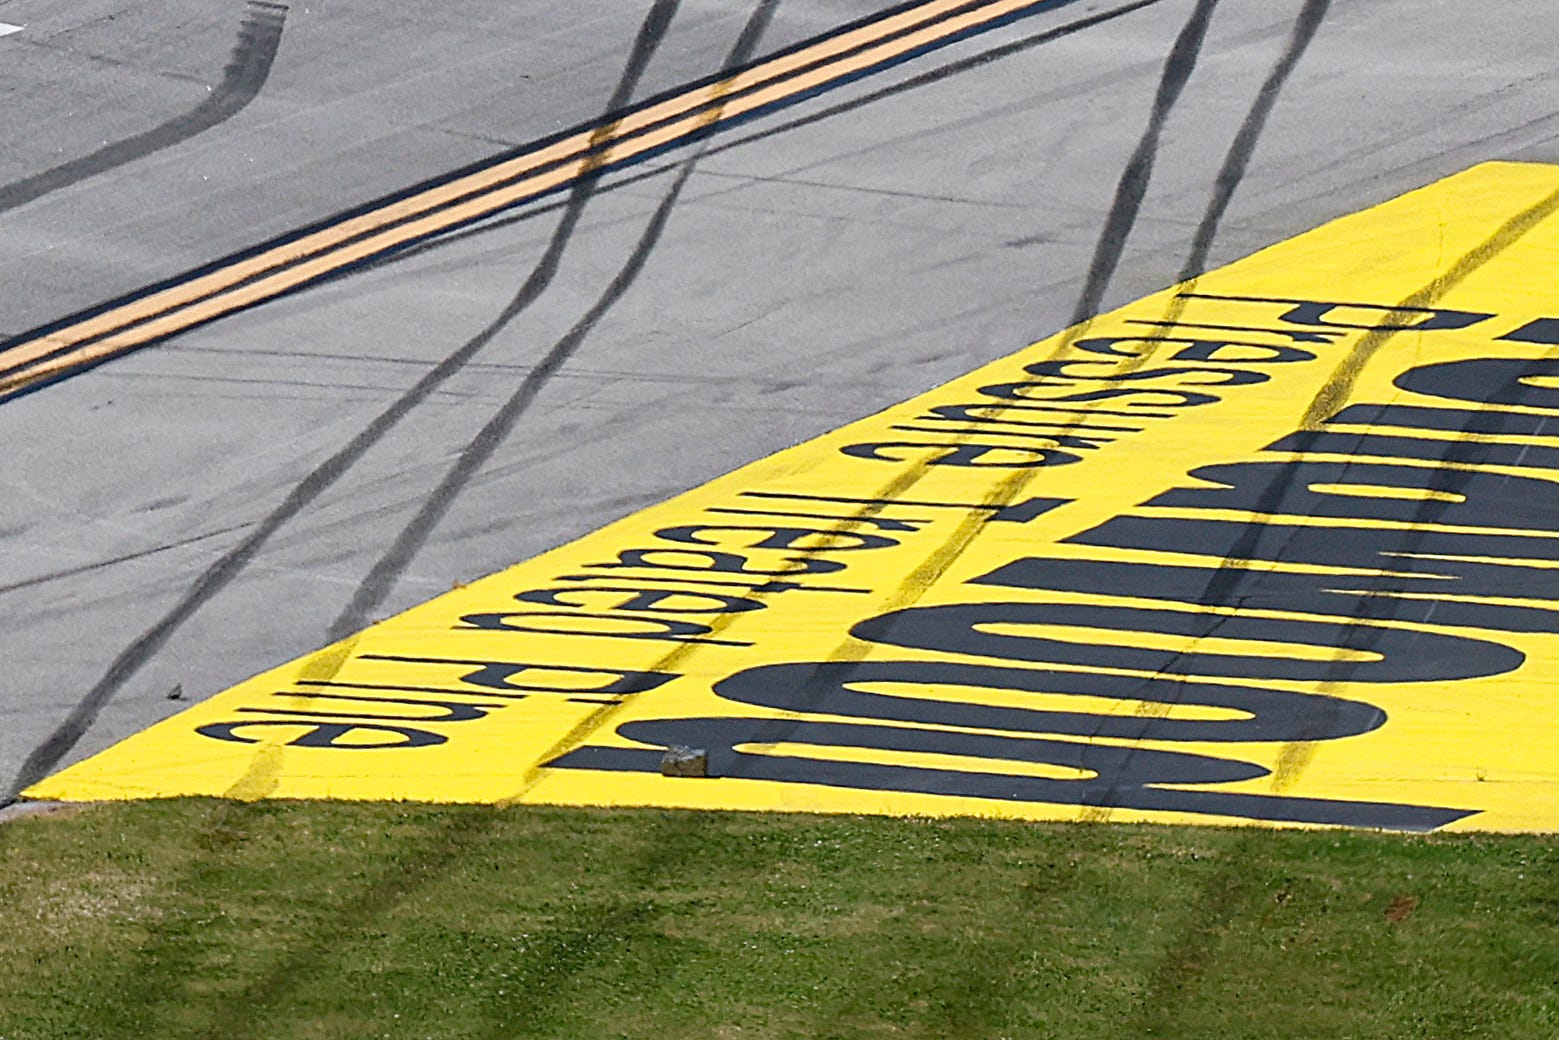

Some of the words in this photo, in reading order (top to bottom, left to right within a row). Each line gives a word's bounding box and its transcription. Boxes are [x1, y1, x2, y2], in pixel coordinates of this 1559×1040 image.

[838, 293, 1498, 468] Pressure
[450, 490, 1072, 646] Treated
[194, 653, 685, 750] Pine
